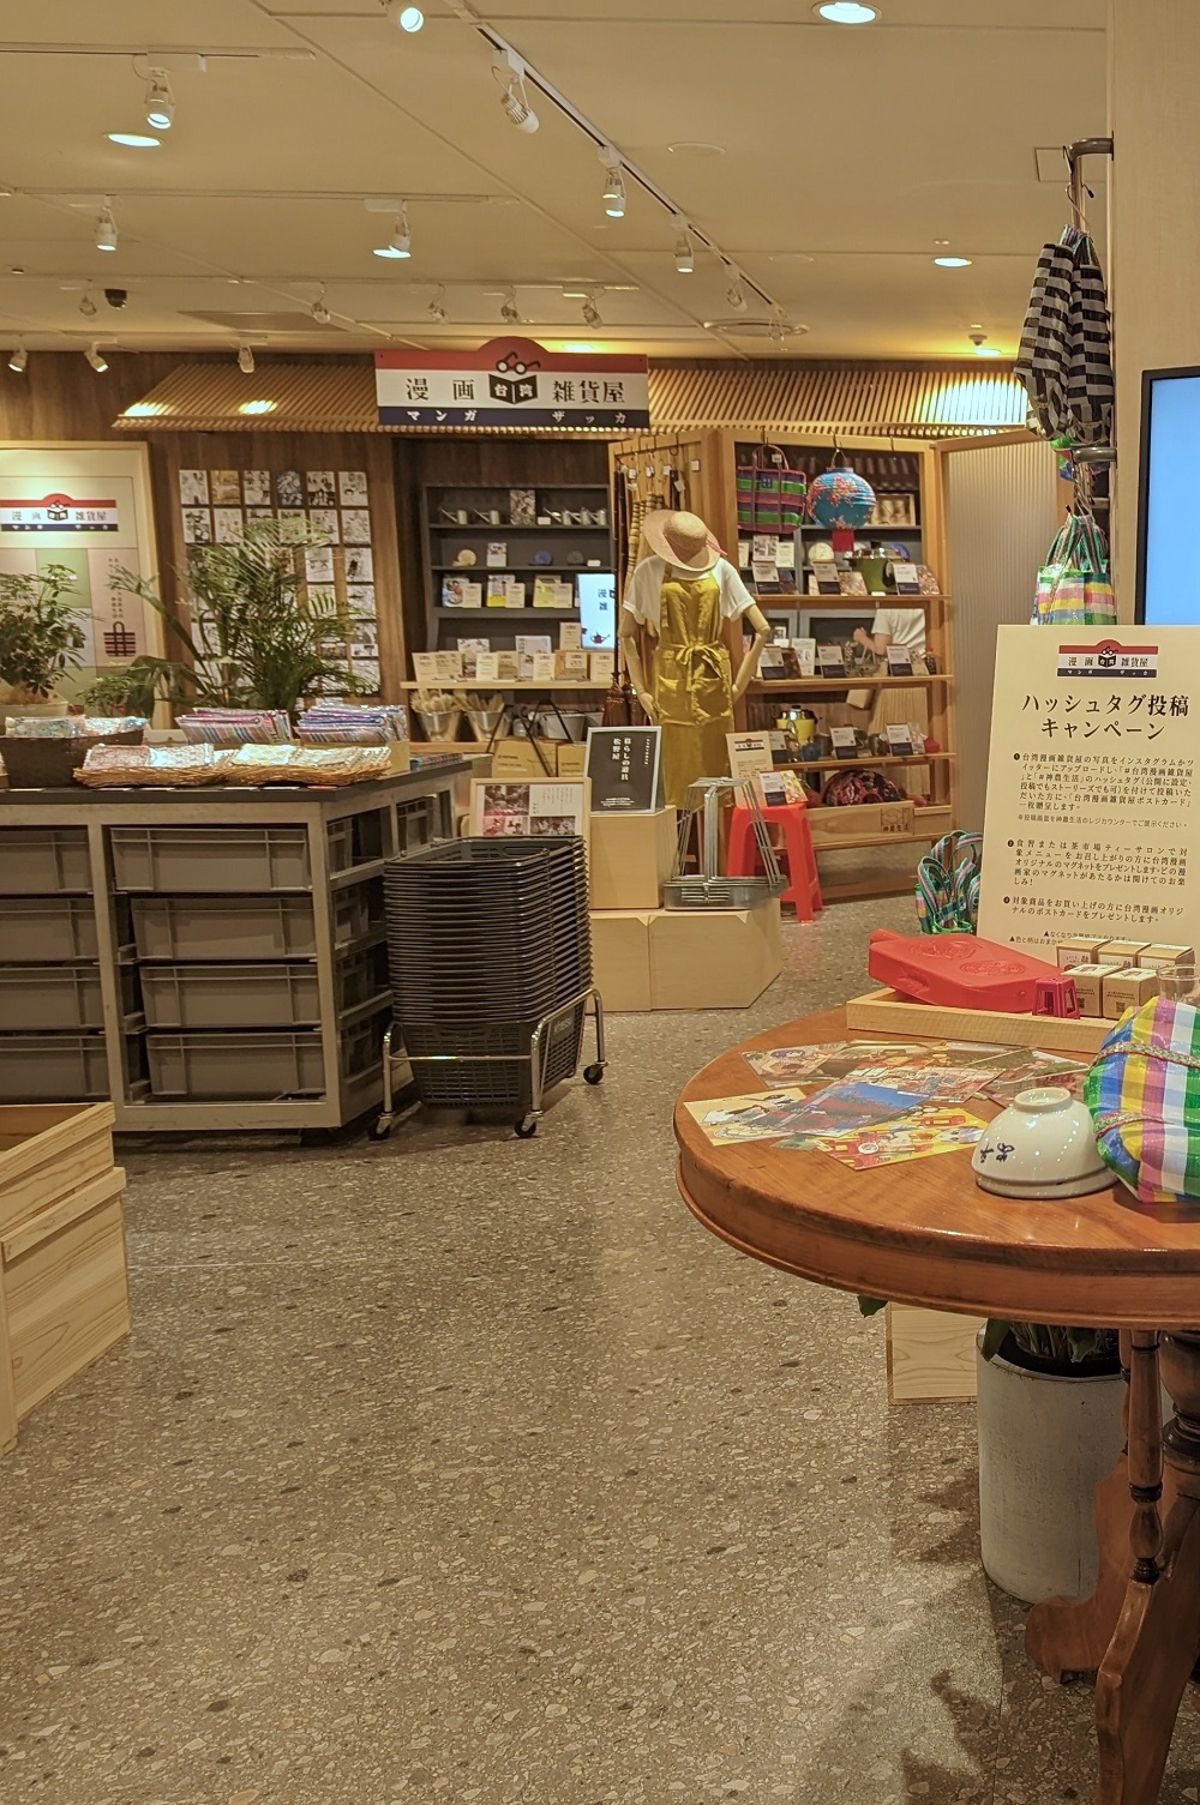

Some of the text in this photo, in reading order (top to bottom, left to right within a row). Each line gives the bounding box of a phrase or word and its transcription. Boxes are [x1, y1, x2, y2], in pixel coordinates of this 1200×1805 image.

[405, 378, 475, 401] 漫画
[552, 380, 625, 403] 雑貨屋
[407, 410, 626, 424] マンガ ザッカ
[1022, 694, 1189, 717] ハッシュタグ投稿
[1041, 718, 1165, 740] キャンペーン
